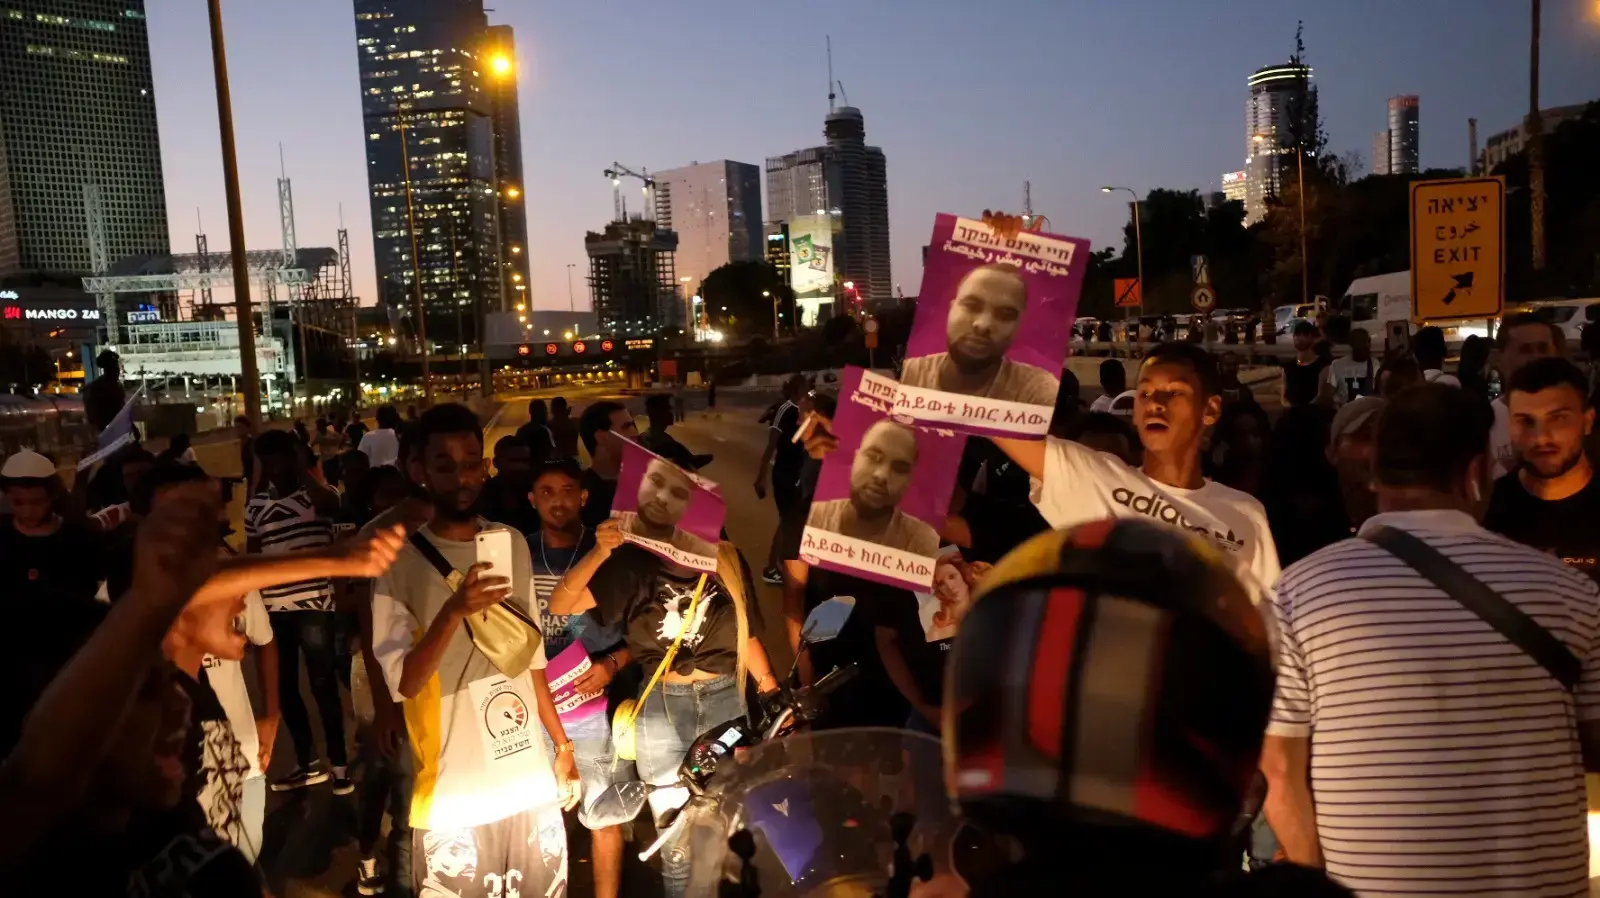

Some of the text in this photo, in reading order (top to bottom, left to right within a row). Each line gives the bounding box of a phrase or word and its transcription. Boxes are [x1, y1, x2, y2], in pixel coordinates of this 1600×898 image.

[1428, 195, 1487, 214] יציאה
[1436, 221, 1480, 241] خروج
[1005, 237, 1041, 253] אינם
[1046, 246, 1069, 260] חיי
[1434, 246, 1481, 264] EXIT
[1025, 259, 1069, 276] حياتي
[25, 308, 77, 320] MANGO
[542, 615, 569, 627] HAS
[546, 627, 563, 637] NO
